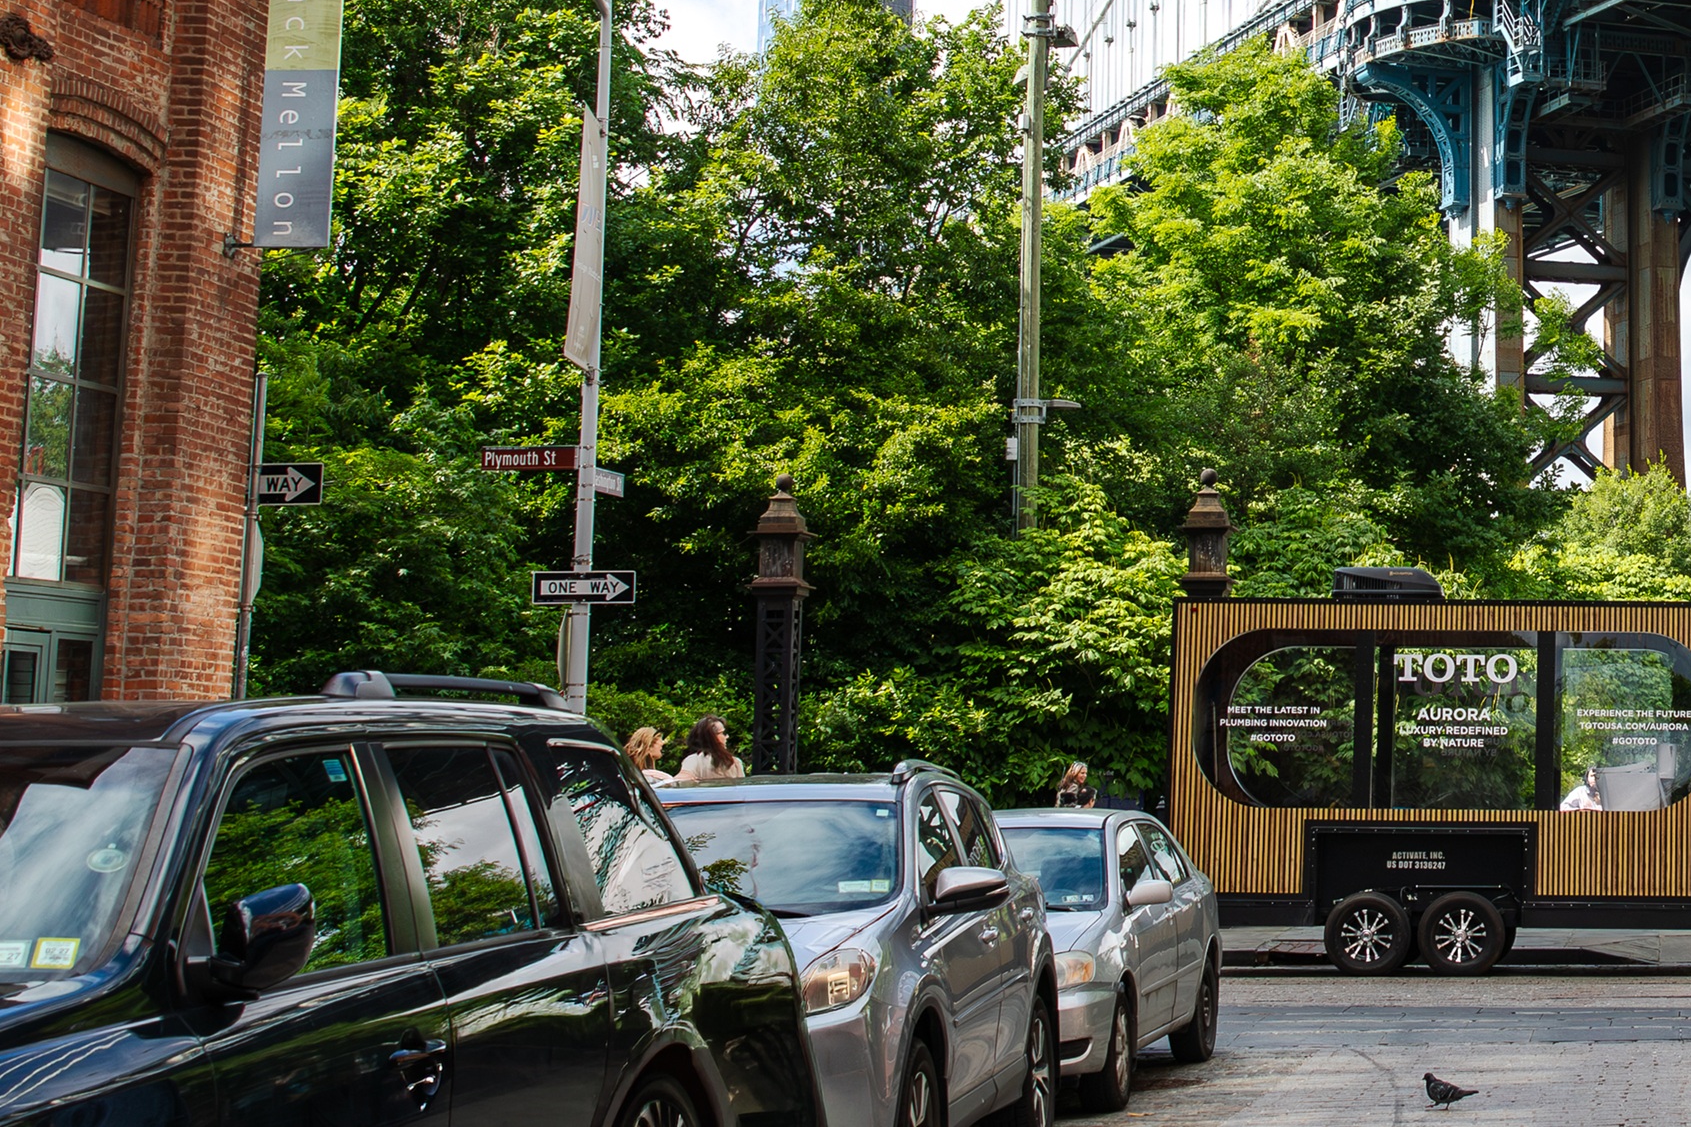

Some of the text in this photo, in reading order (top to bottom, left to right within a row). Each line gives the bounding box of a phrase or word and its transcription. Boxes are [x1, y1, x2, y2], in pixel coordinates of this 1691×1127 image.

[273, 81, 307, 236] Mellon
[484, 450, 557, 469] Plymouth St
[266, 476, 303, 492] WAY
[548, 581, 620, 593] ONE WAY
[1393, 653, 1518, 684] TOTO
[1227, 706, 1320, 714] MEET THE LATEST IN
[1417, 707, 1491, 722] AURORA
[1576, 709, 1691, 718] EXPERIENCE THE FUTURE
[1219, 718, 1327, 727] PLUMBING INNOVATION
[1579, 721, 1689, 731] TOTOUSA.COM/AURORA
[1399, 725, 1509, 736] LUXURY REDEFINED
[1250, 734, 1296, 742] #GOTOTO
[1423, 738, 1438, 747] BY
[1439, 738, 1485, 748] NATURE
[1612, 737, 1658, 746] #GOTOTO
[1392, 851, 1446, 860] ACTIVATE, INC.
[1386, 860, 1446, 870] US DOT 3136247
